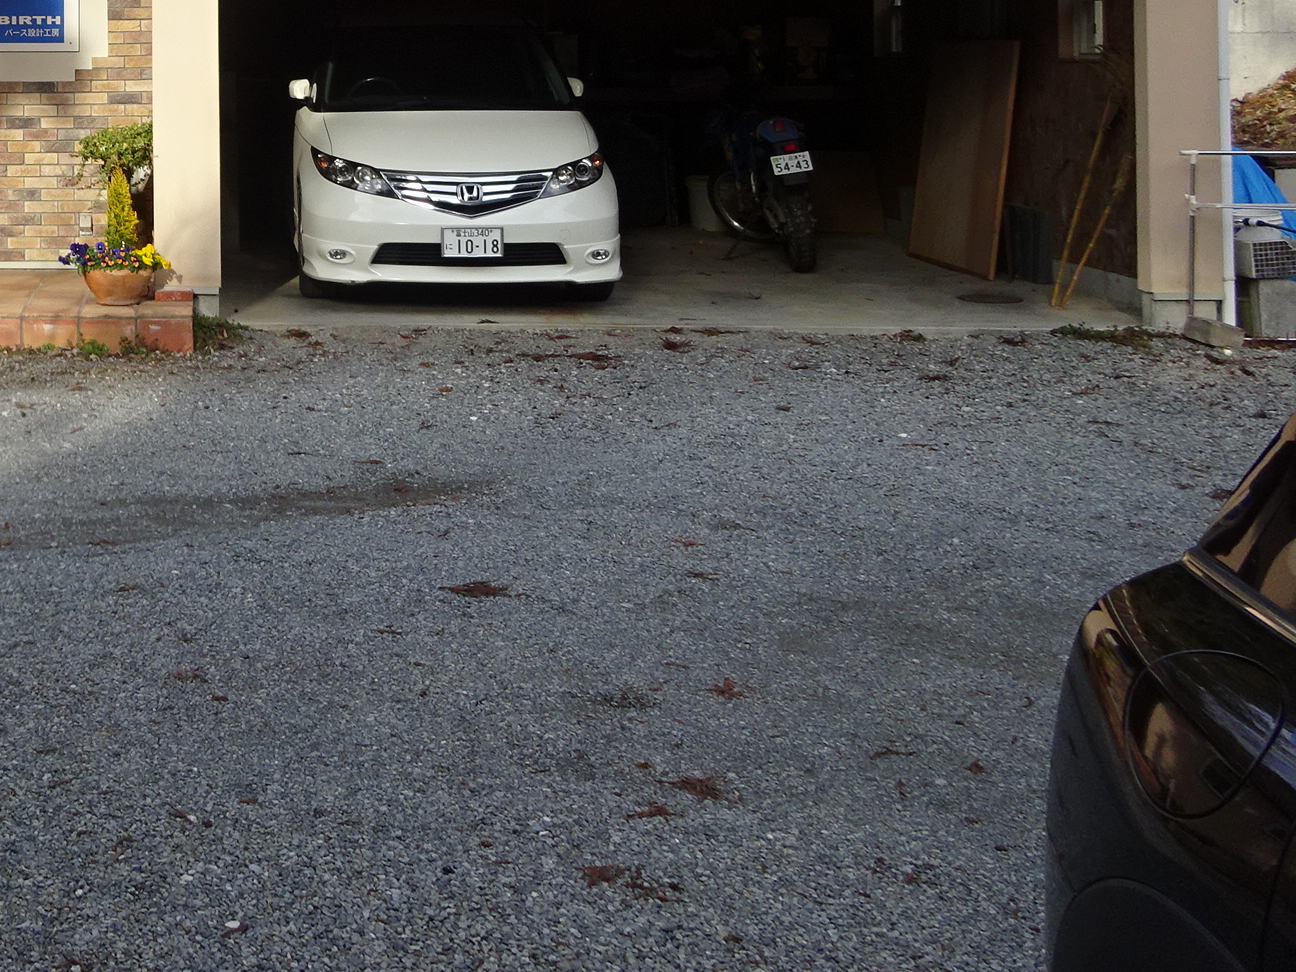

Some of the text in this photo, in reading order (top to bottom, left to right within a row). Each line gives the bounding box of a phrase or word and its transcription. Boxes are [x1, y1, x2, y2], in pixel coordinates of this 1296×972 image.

[4, 28, 60, 37] バース設計工房
[775, 159, 810, 173] 54-43
[457, 238, 500, 254] 10-18
